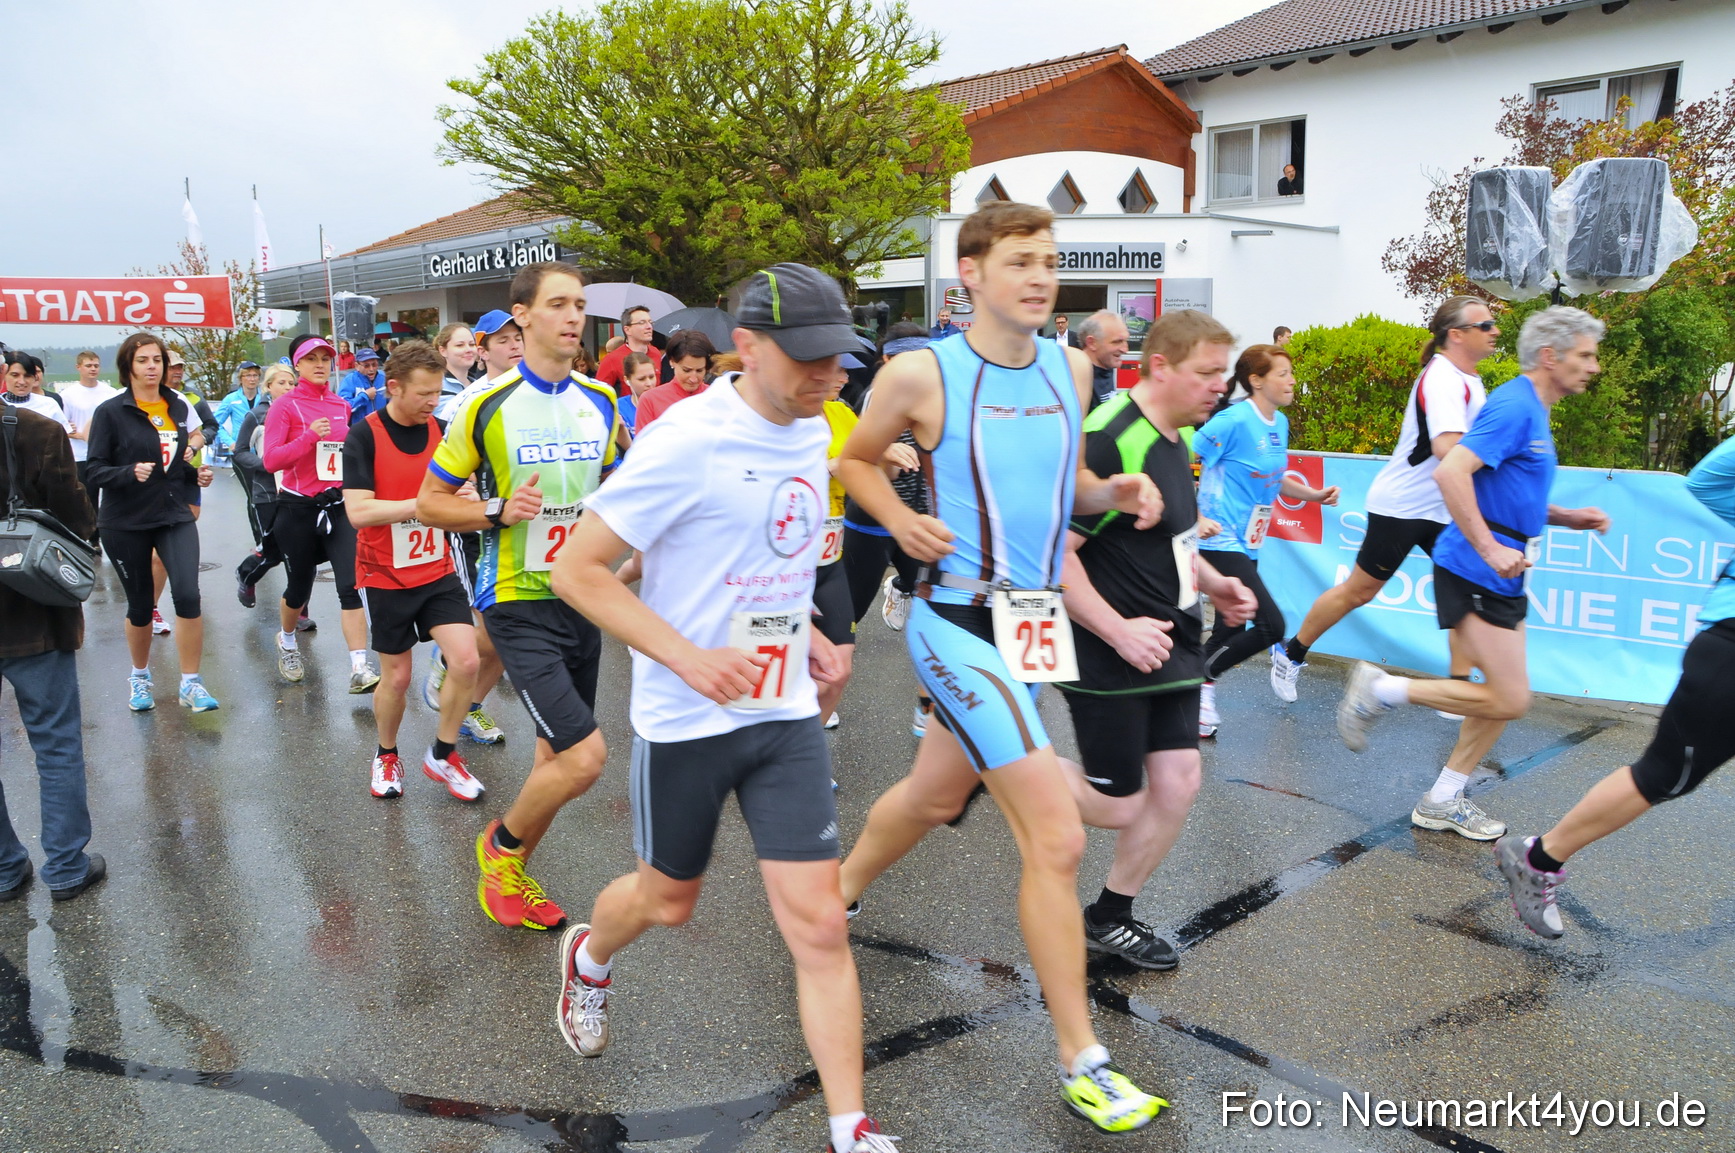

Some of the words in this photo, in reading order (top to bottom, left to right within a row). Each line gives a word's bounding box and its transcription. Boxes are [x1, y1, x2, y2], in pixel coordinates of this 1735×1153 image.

[430, 251, 489, 278] Gerhart
[494, 247, 506, 269] &
[516, 427, 572, 442] TEAM
[327, 453, 336, 475] 4
[516, 440, 600, 465] BOCK
[542, 506, 575, 516] MEYER
[408, 528, 437, 560] 24
[544, 522, 580, 564] 2
[1015, 620, 1058, 672] 25
[751, 643, 788, 699] 71
